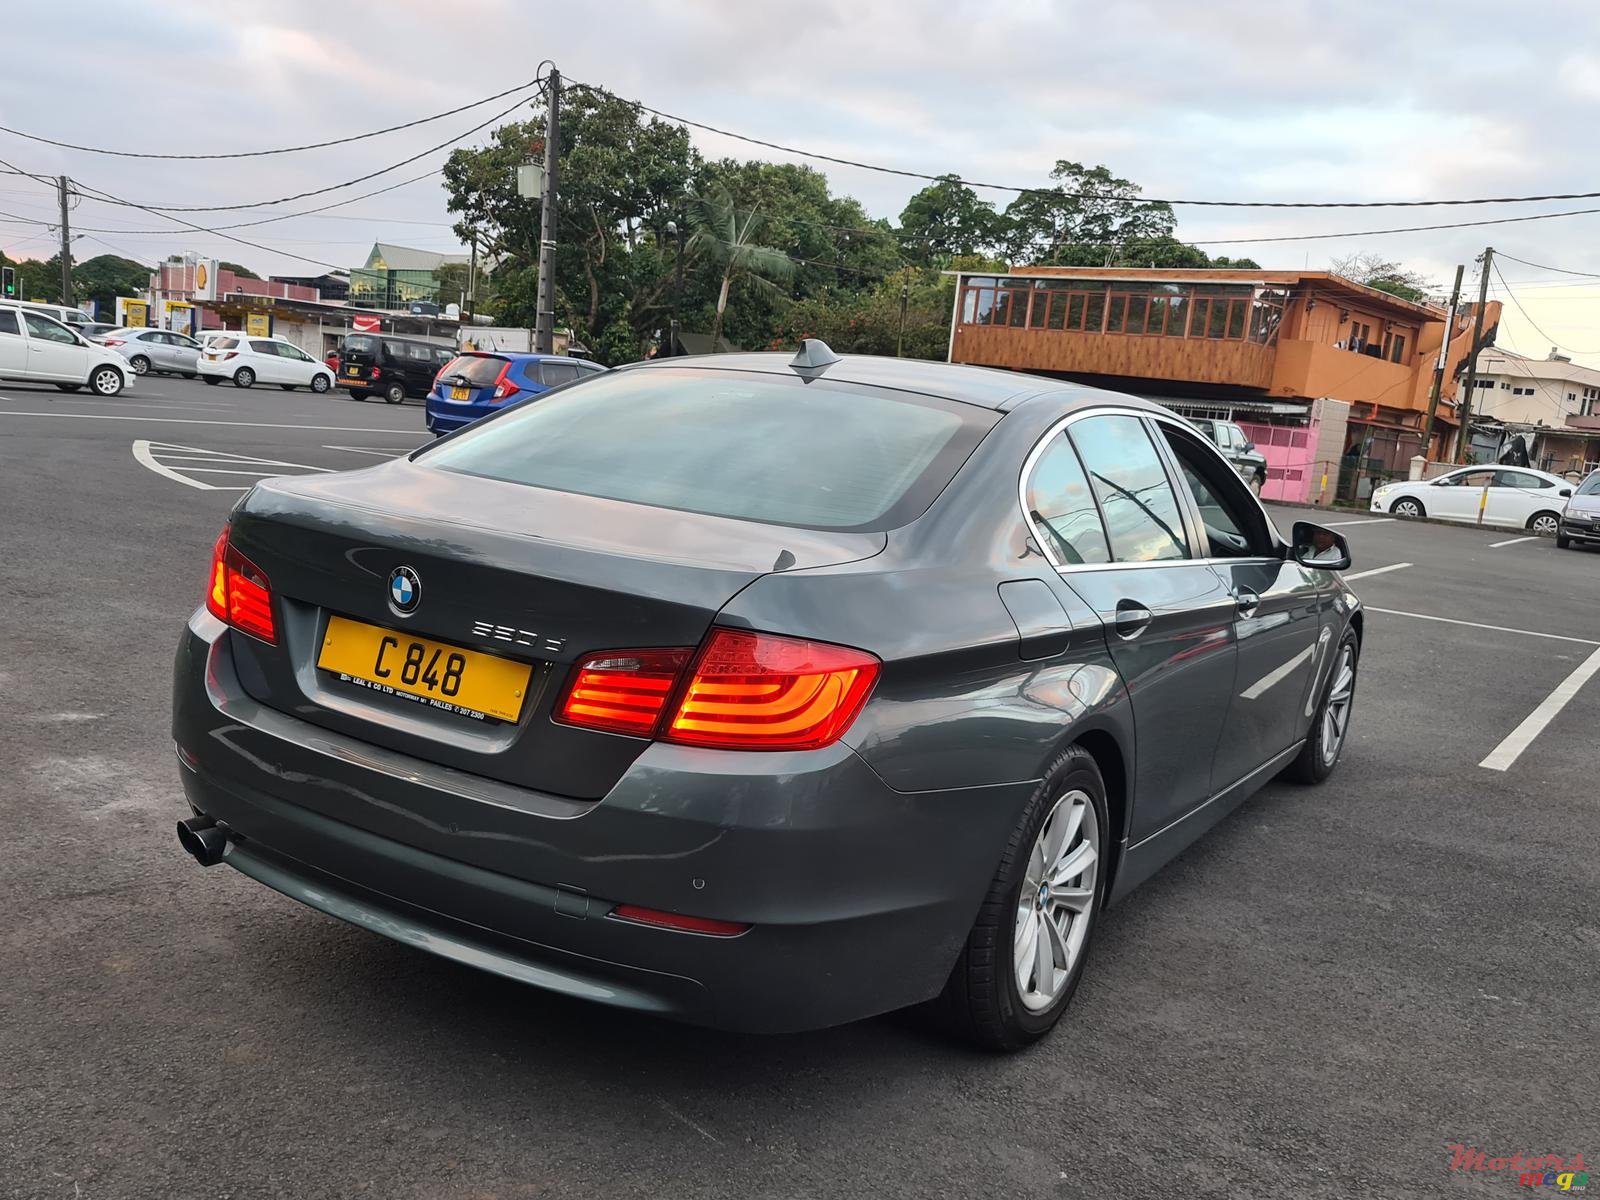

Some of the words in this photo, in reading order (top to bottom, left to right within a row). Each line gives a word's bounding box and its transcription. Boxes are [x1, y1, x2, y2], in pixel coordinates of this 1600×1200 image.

[374, 636, 398, 678] C
[401, 642, 466, 697] 848
[353, 677, 366, 687] LEAL
[373, 683, 382, 691] CO
[382, 686, 394, 694] LTD
[430, 699, 453, 711] PAILLES
[460, 707, 471, 717] 207
